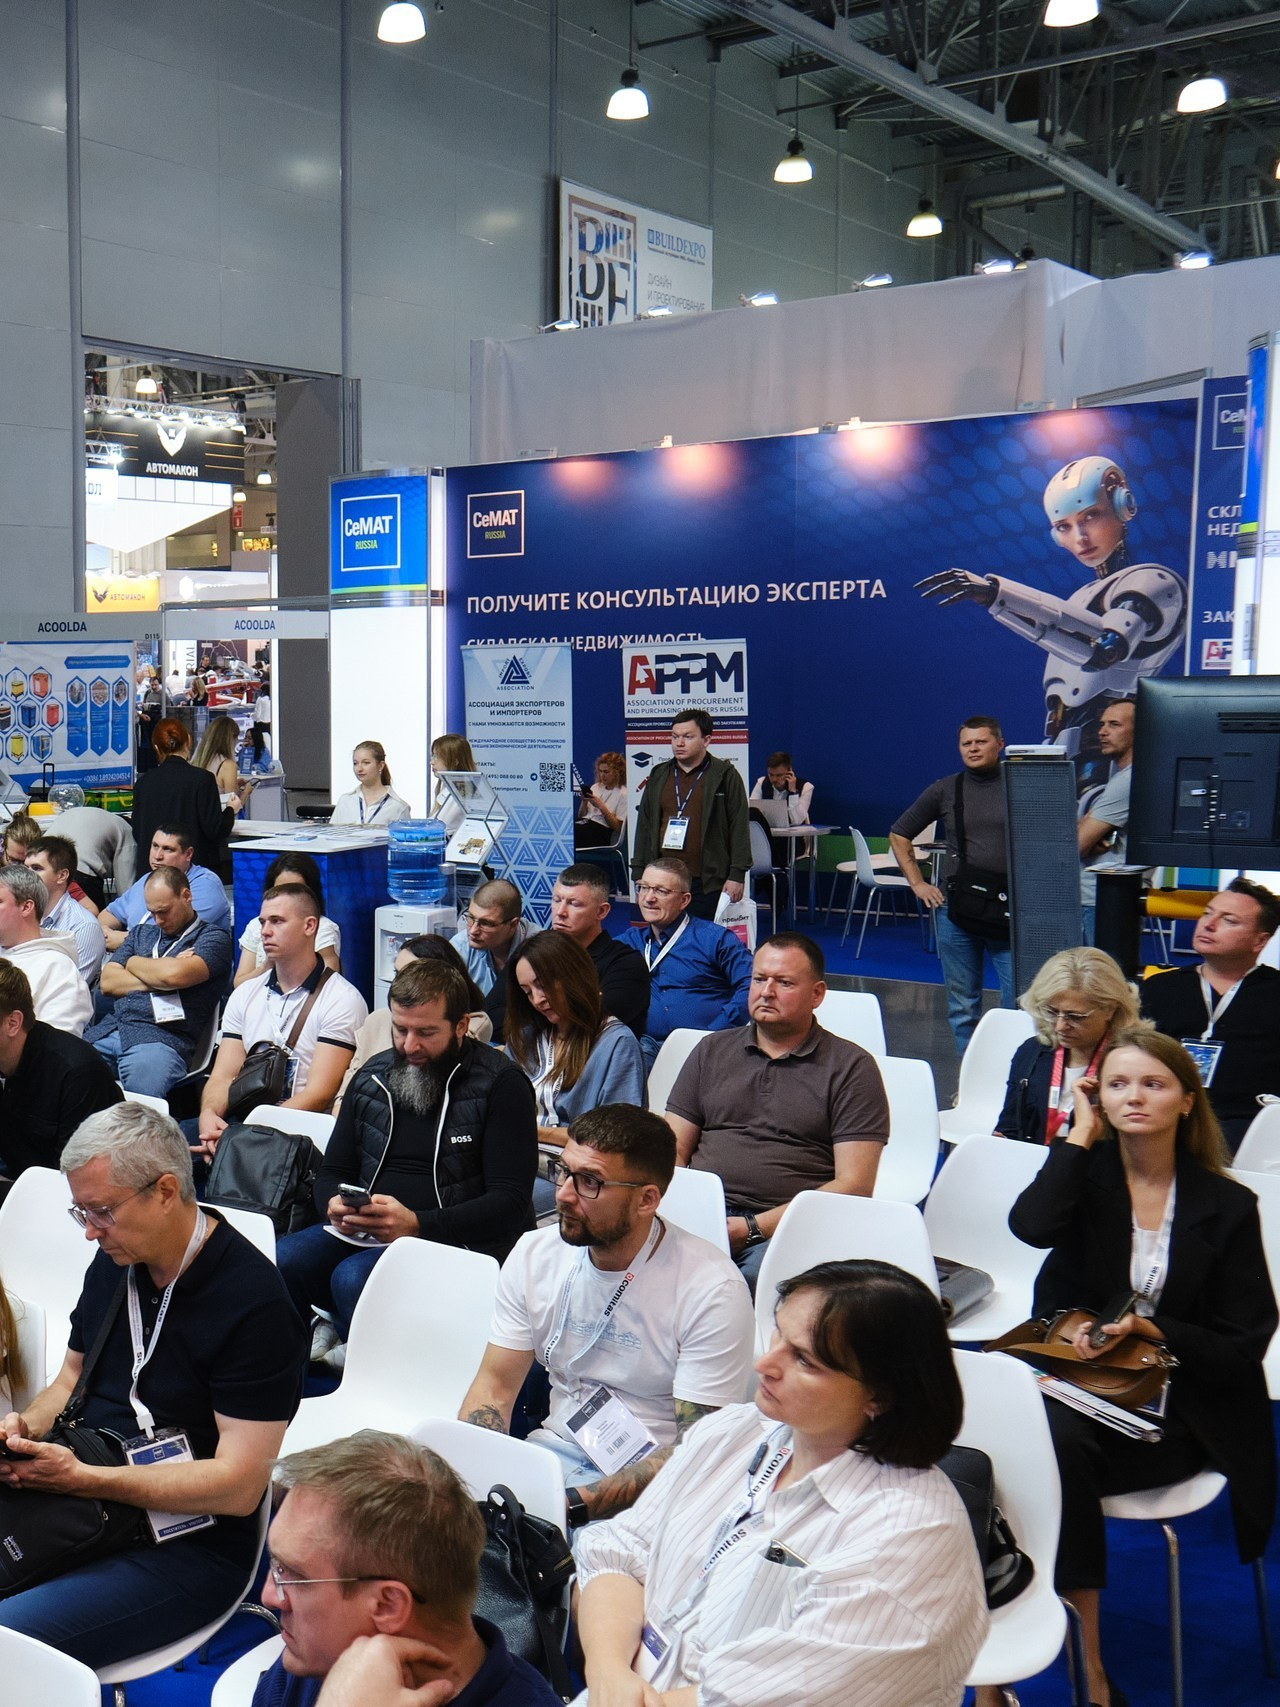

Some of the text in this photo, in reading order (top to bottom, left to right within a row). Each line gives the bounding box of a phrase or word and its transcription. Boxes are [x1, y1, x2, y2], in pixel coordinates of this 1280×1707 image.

[655, 230, 706, 260] BUILDEXPO
[146, 461, 199, 477] АВТОМАКОН
[344, 515, 393, 537] CeMAT
[472, 508, 519, 528] CeMAT
[484, 530, 506, 540] RUSSIA
[355, 539, 378, 550] RUSSIA
[109, 593, 146, 601] АВТОМАКОН
[467, 578, 887, 614] ПОЛУЧИТЕ КОНСУЛЬТАЦИЮ ЭКСПЕРТА
[37, 621, 87, 633] ACOOLDA
[234, 619, 276, 631] ACOOLDA
[498, 658, 510, 679] IMPORT
[519, 657, 532, 678] EXPORT
[627, 651, 744, 695] APPM
[515, 700, 565, 708] ЭКСПОРТЕРОВ
[626, 697, 744, 706] ASSOCIATION OF PROCUREMENT
[496, 709, 542, 717] ИМПОРТЕРОВ
[451, 1135, 472, 1144] BOSS
[603, 1279, 629, 1317] comitas
[747, 1452, 784, 1498] comitas
[703, 1528, 747, 1571] comitas
